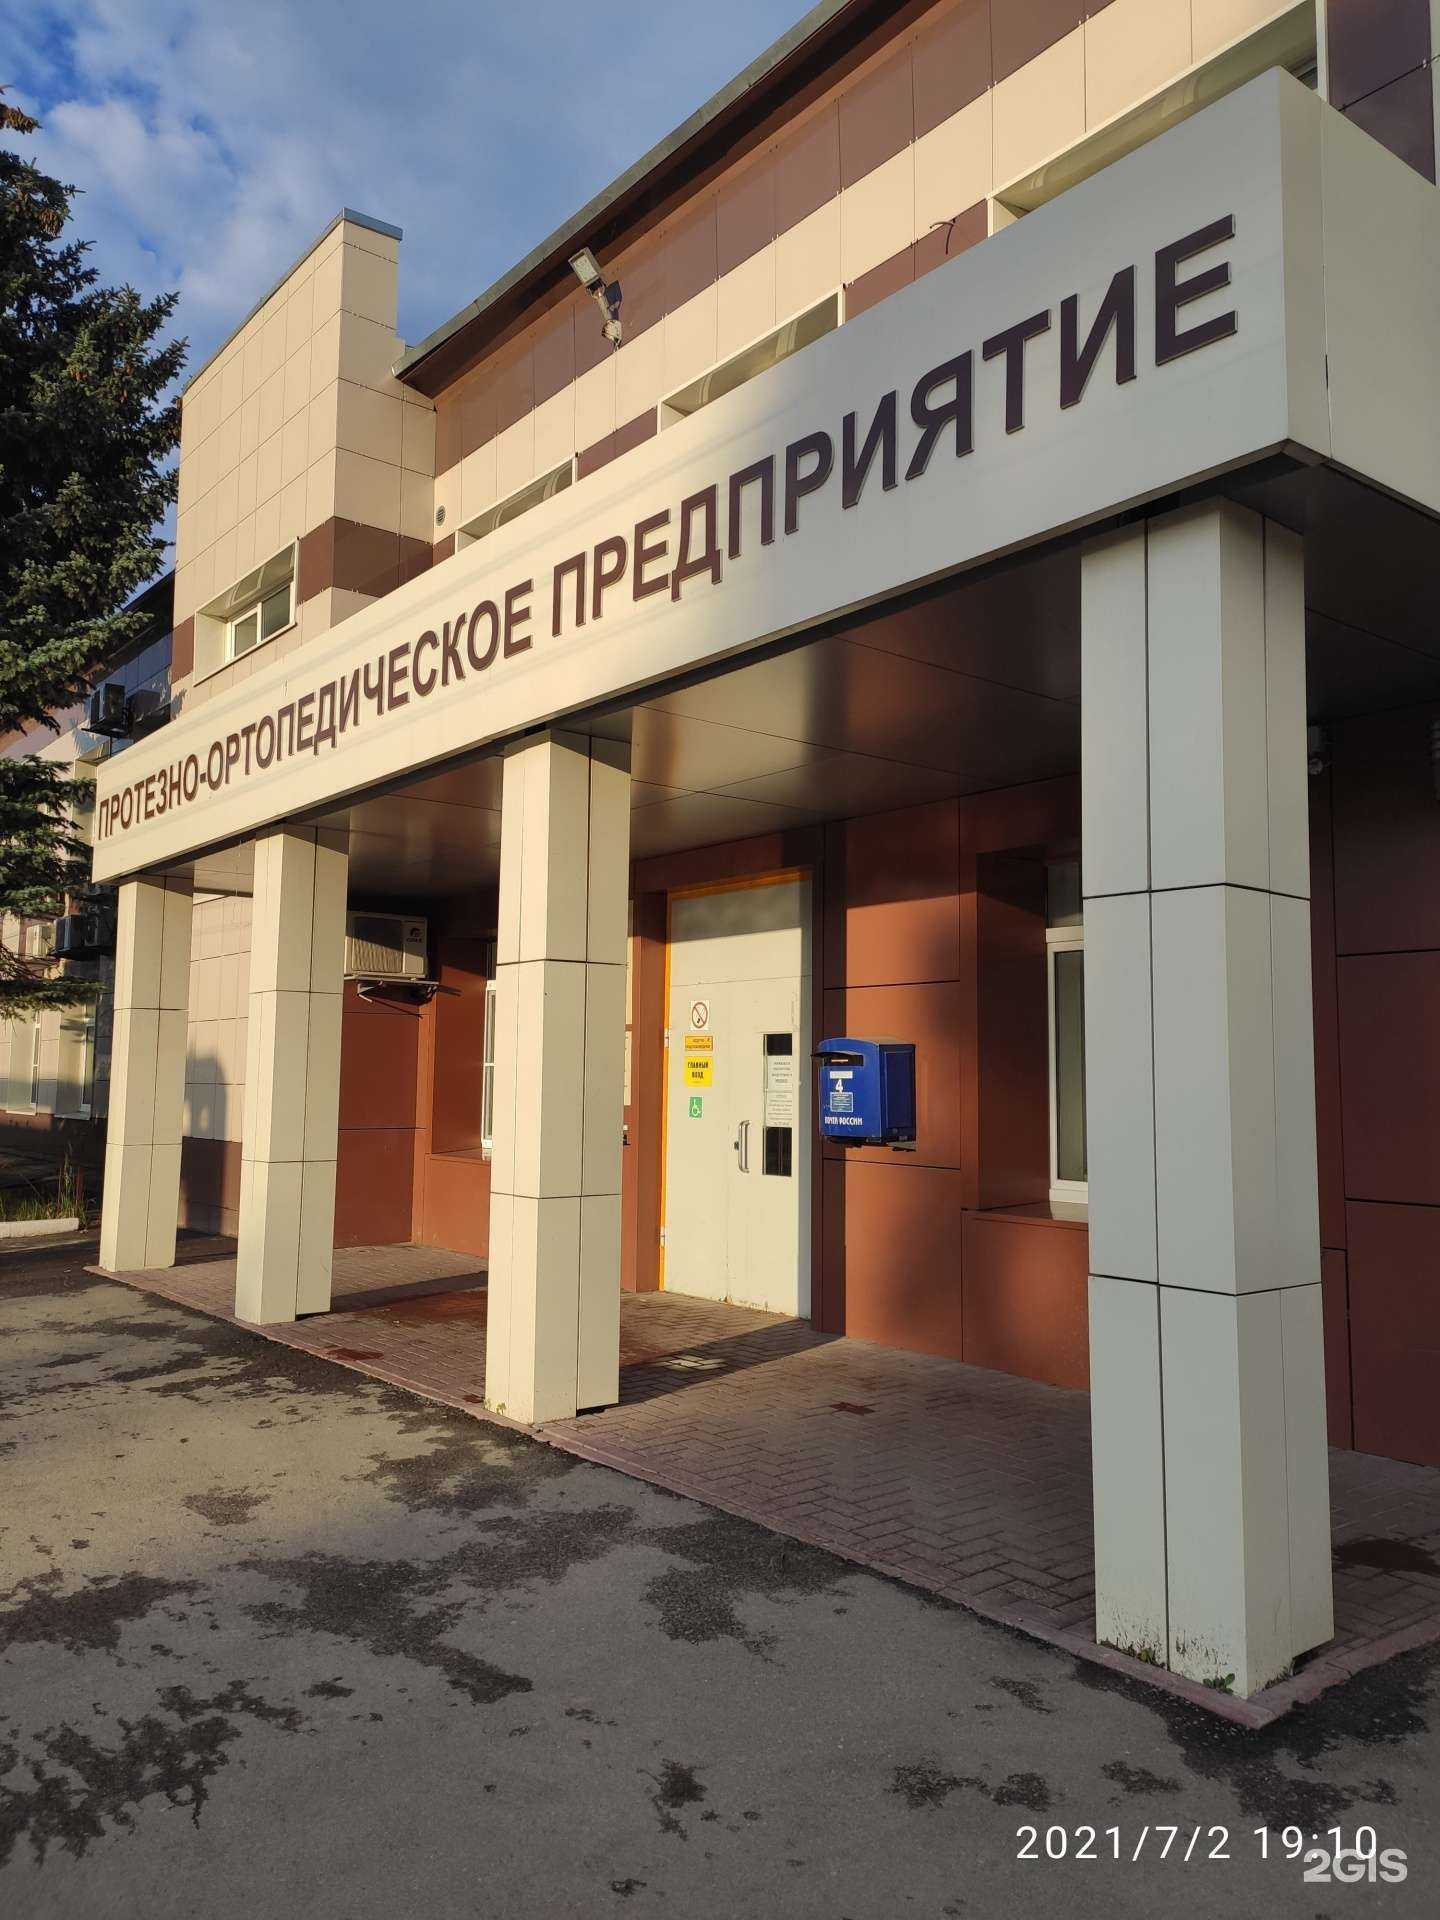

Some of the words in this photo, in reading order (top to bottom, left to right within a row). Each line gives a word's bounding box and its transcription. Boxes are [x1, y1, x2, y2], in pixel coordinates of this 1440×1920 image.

[99, 579, 534, 840] ПРОТЕЗНО-ОРТОПЕДИЧЕСКОЕ
[551, 213, 1238, 638] ПРЕДПРИЯТИЕ
[835, 1079, 843, 1094] 4
[839, 1117, 863, 1126] РОССИИ
